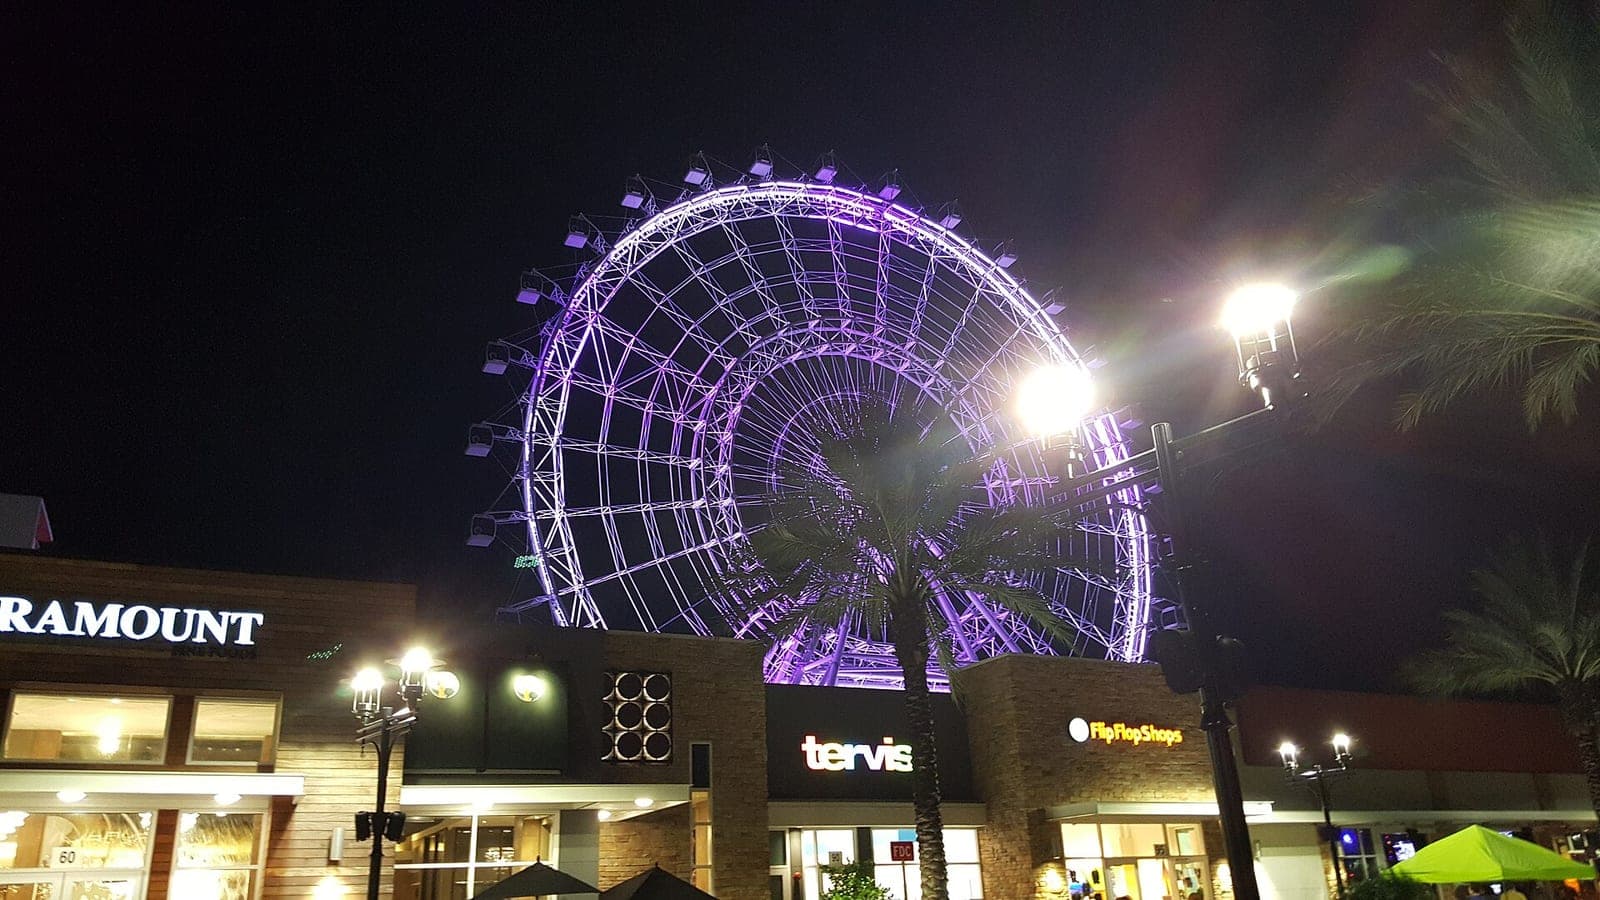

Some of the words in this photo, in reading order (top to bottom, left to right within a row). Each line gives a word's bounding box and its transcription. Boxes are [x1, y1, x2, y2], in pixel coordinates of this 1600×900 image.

[0, 597, 263, 644] RAMOUNT
[802, 736, 913, 771] tervis
[59, 851, 75, 863] 60
[893, 846, 911, 857] FDC
